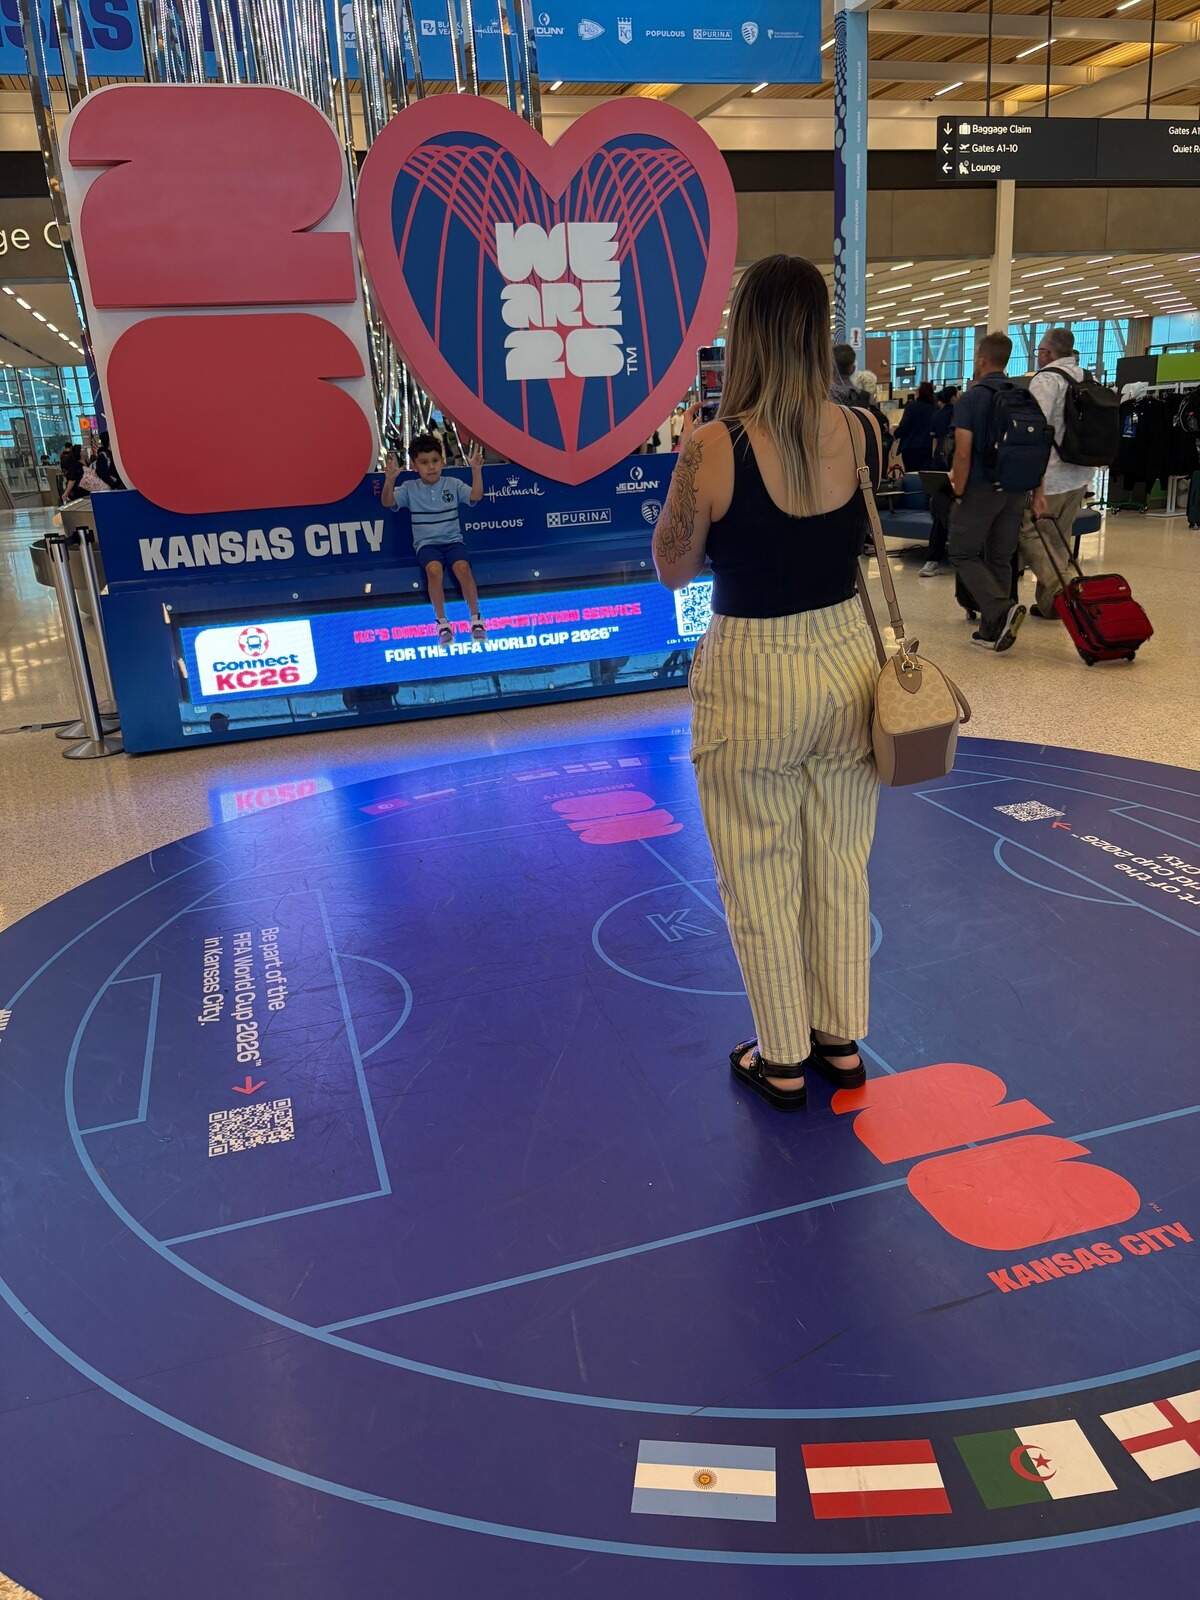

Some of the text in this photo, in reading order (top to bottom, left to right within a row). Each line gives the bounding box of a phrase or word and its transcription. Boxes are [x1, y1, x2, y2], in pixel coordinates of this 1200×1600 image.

[972, 124, 1032, 135] Baggage Claim
[1168, 126, 1190, 135] Gates
[971, 144, 1019, 153] Gates A1-10
[1172, 145, 1192, 154] Quiet
[971, 163, 1001, 173] Lounge
[495, 222, 620, 281] WE
[504, 328, 624, 381] 26
[484, 482, 545, 503] Hallmark
[465, 519, 524, 532] POPULOUS
[562, 511, 610, 524] PURINA
[139, 519, 385, 571] KANSAS CITY
[582, 603, 641, 620] SERVICE
[385, 649, 417, 663] FOR
[418, 643, 448, 659] THE
[450, 641, 482, 656] FIFA
[484, 634, 538, 652] WORLD
[539, 631, 570, 646] CUP
[212, 654, 299, 672] Connect
[216, 666, 300, 691] KC26
[1113, 863, 1153, 881] the
[1130, 856, 1175, 876] Cup
[1145, 881, 1181, 893] of
[232, 931, 252, 956] FIFA
[233, 954, 256, 992] World
[258, 927, 289, 1011] Be part of the
[197, 936, 225, 1026] in Kansas City.
[230, 992, 256, 1021] Cup
[986, 1221, 1195, 1294] KANSAS CITY
